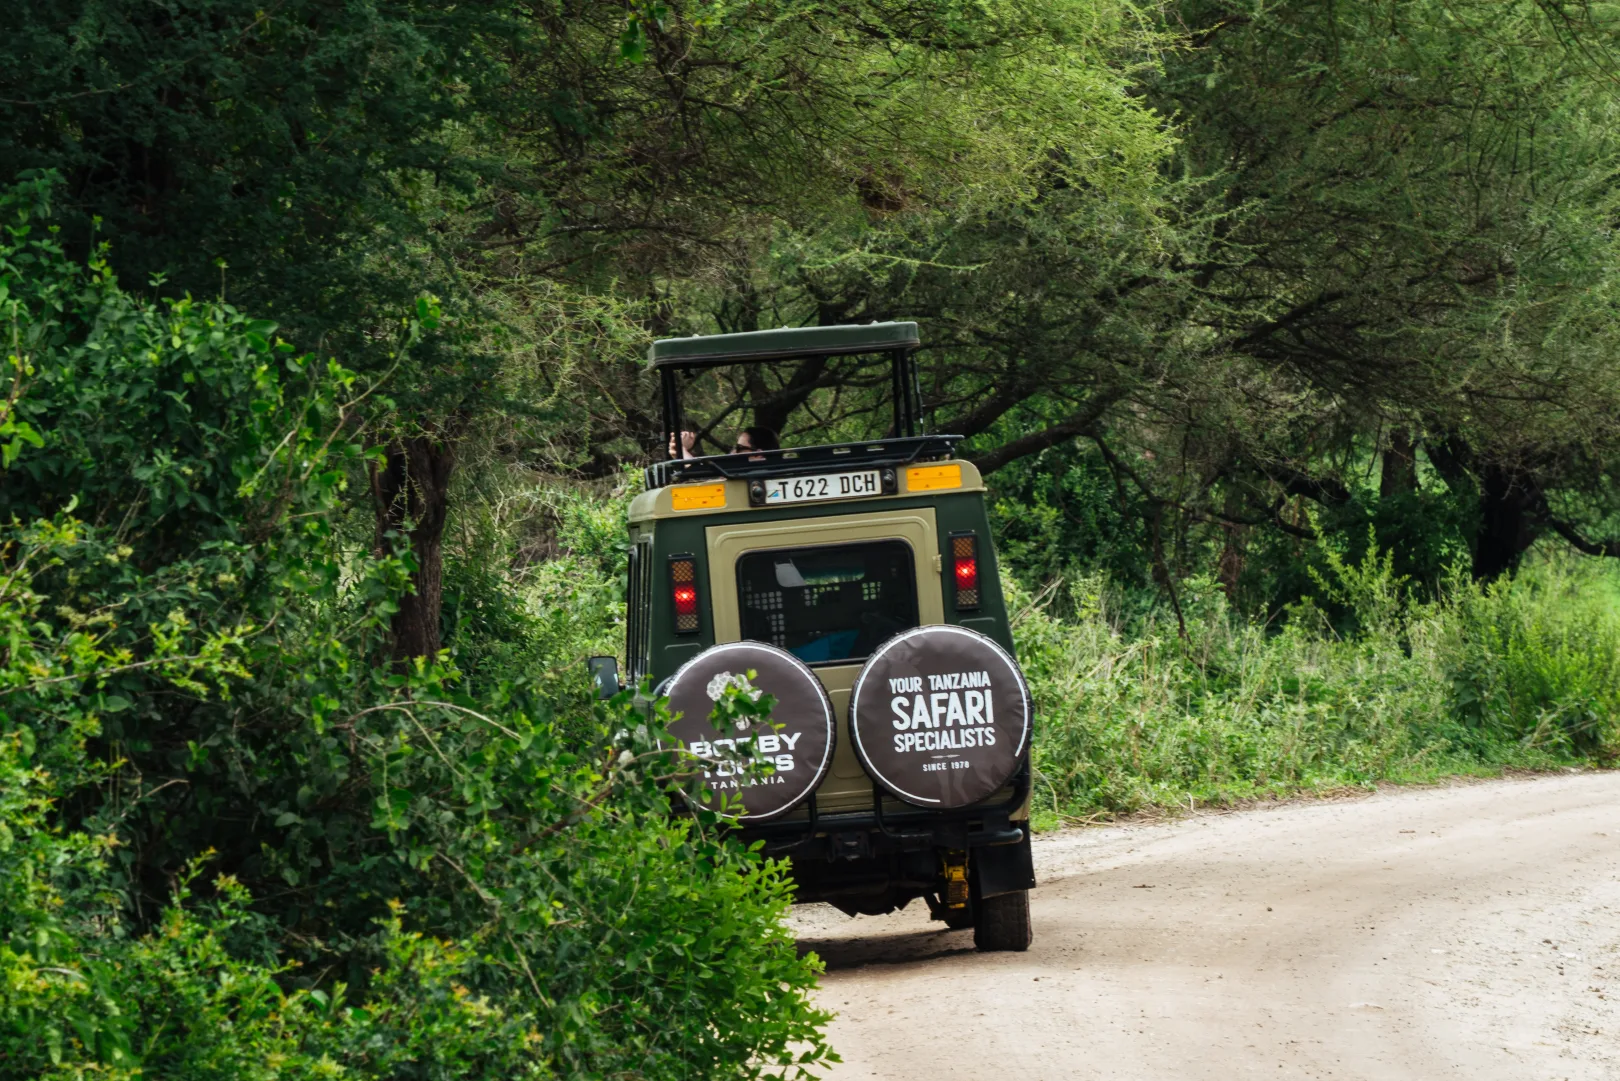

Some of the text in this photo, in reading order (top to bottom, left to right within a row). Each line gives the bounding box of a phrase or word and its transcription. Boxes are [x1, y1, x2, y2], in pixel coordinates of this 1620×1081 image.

[778, 473, 876, 499] T 622 DCH
[888, 670, 991, 694] YOUR TANZANIA
[890, 689, 994, 731] SAFARI
[893, 727, 996, 753] SPECIALISTS
[922, 763, 947, 772] SINCE
[711, 776, 785, 790] TANANIA
